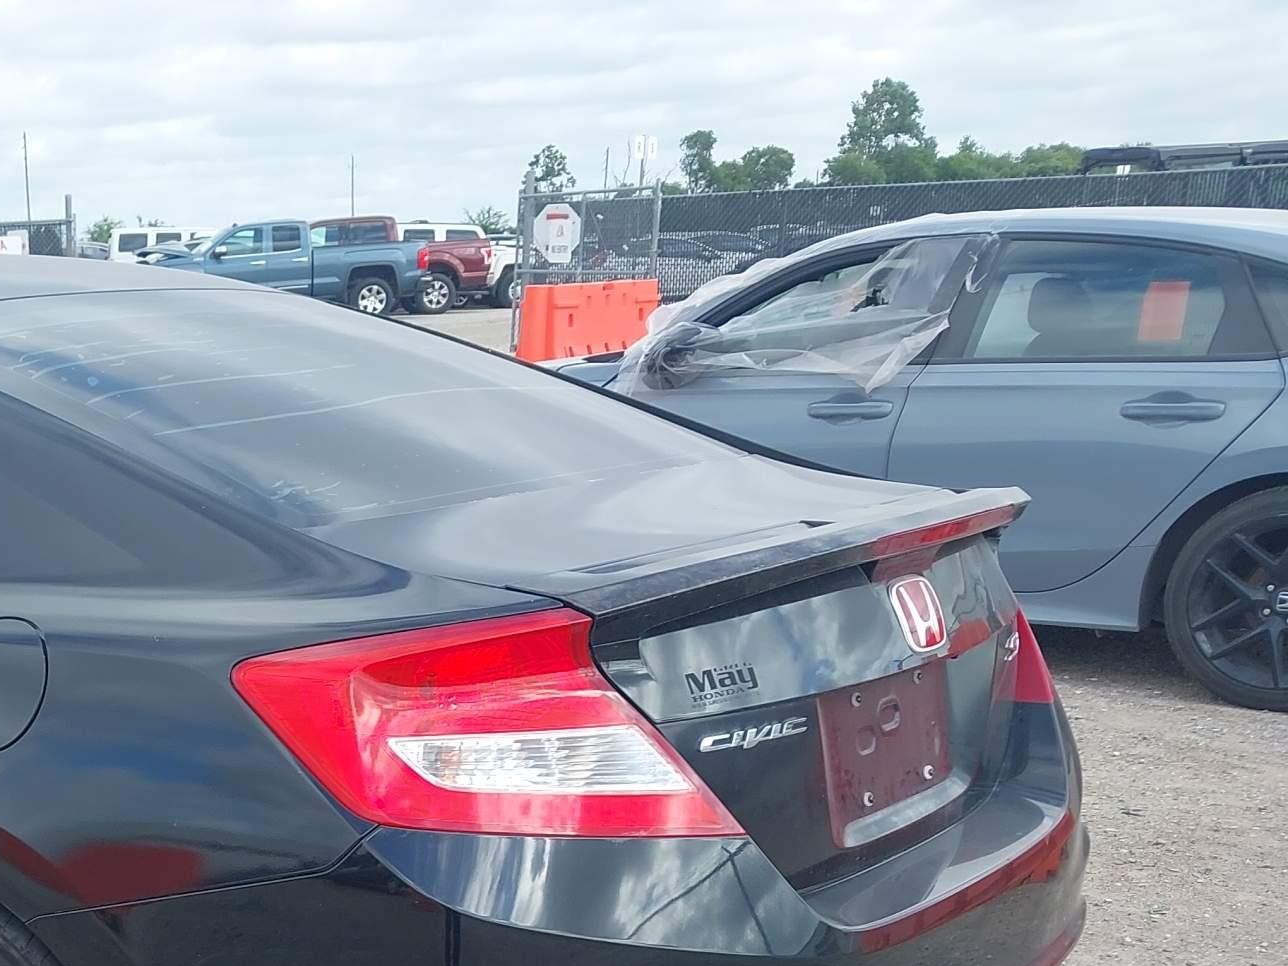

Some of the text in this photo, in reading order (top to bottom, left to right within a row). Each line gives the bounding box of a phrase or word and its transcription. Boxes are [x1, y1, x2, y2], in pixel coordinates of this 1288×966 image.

[684, 666, 759, 695] May
[691, 687, 745, 702] HONDA
[699, 717, 808, 752] CIVIC
